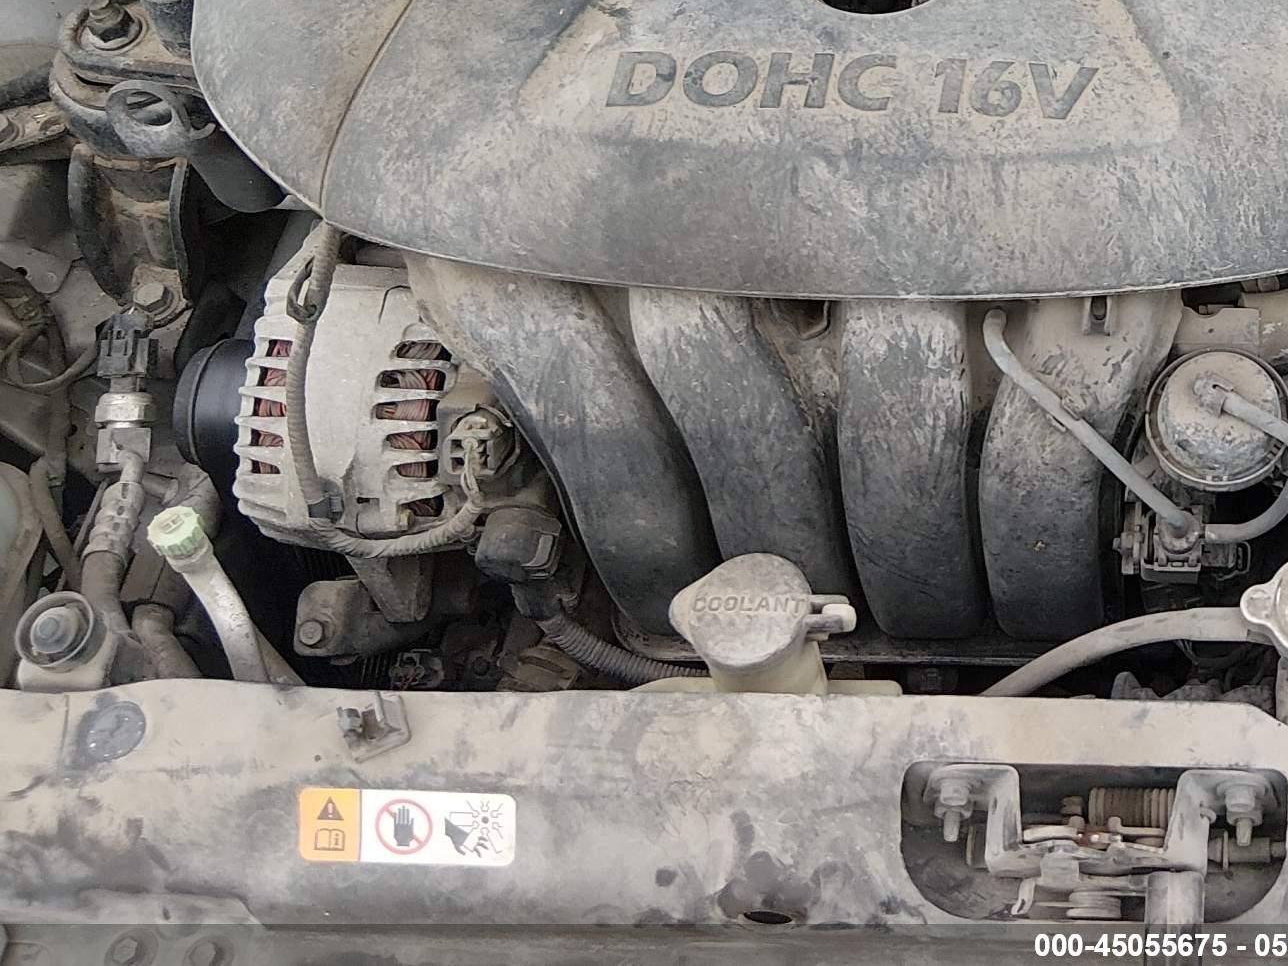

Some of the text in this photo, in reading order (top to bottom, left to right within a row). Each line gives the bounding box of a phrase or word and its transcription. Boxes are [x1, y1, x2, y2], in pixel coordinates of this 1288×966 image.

[605, 50, 1099, 120] DOHC 16V
[693, 596, 806, 614] COOLANT
